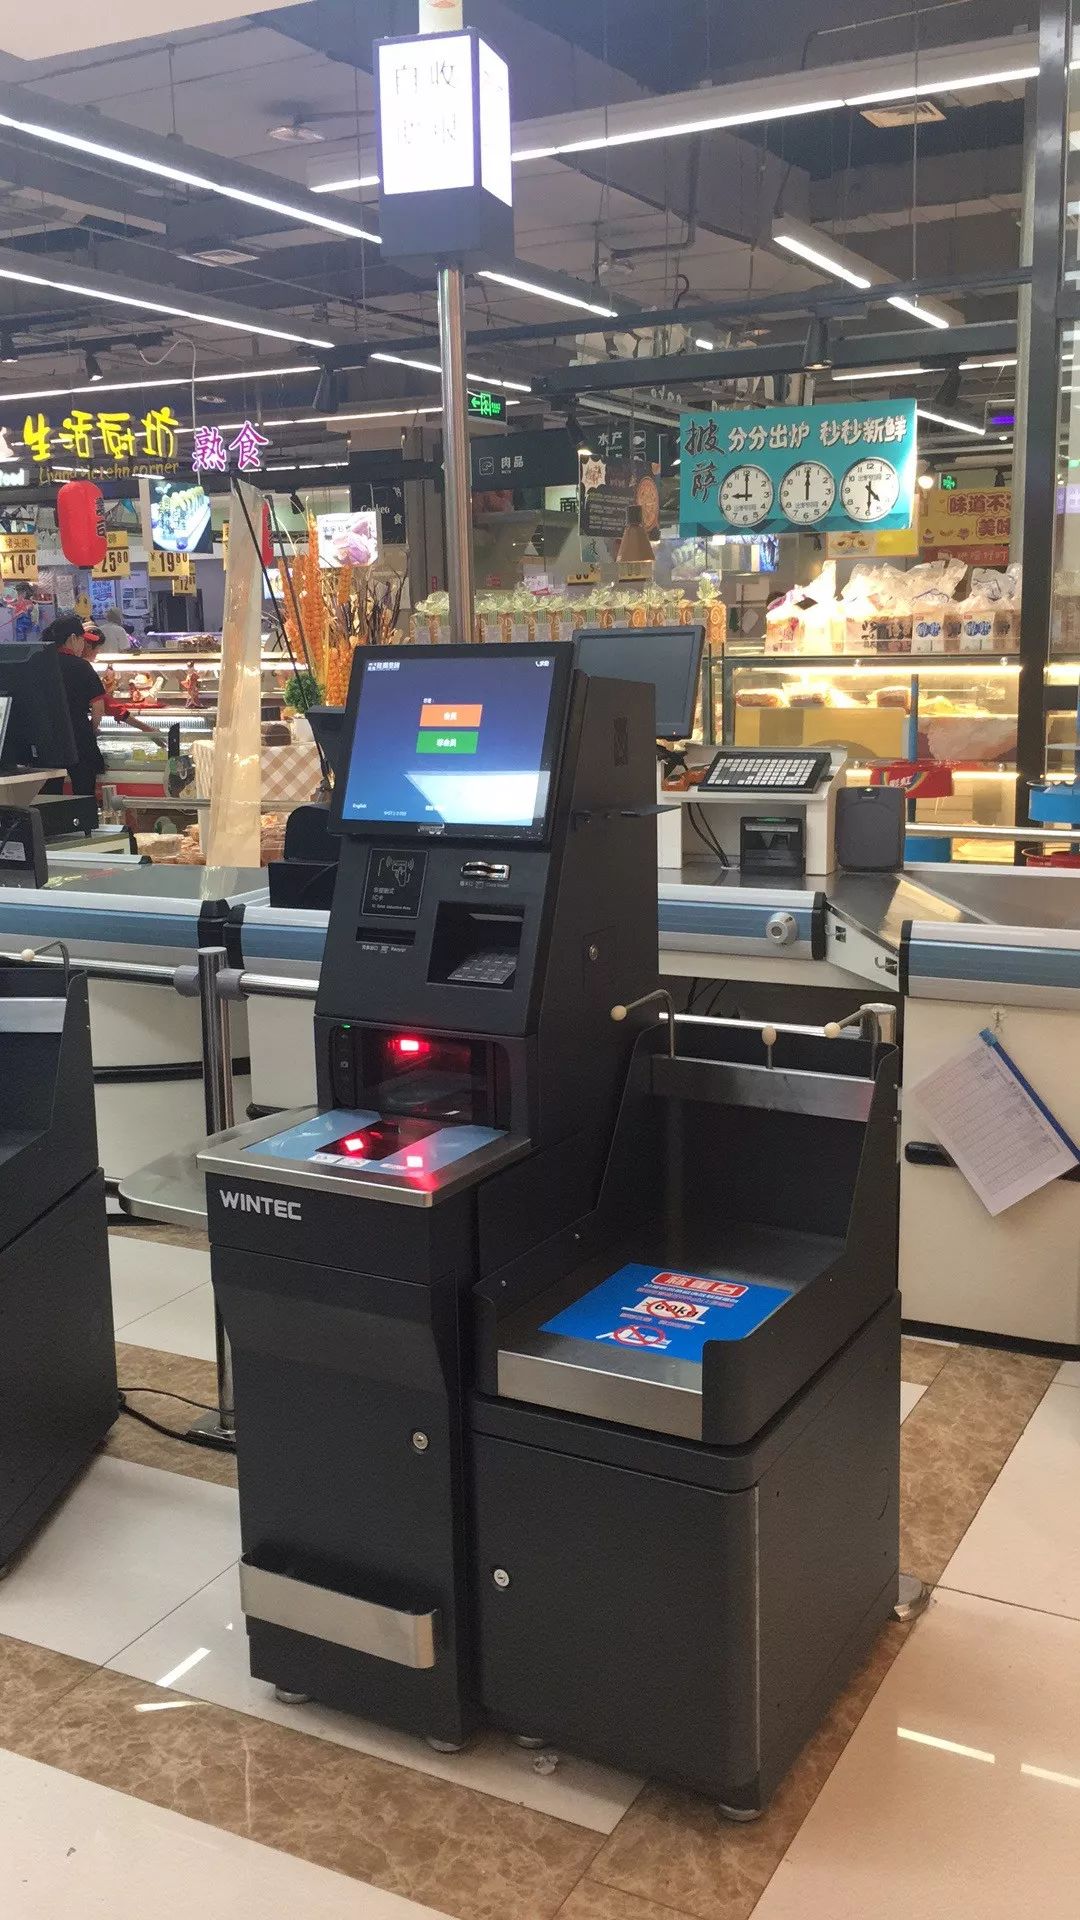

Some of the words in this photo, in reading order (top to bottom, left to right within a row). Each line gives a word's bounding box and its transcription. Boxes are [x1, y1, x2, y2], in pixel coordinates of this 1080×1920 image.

[192, 420, 269, 472] 熟食
[728, 421, 811, 452] 分分出炉
[818, 415, 907, 447] 秒秒新鲜
[501, 455, 524, 469] 肉品
[219, 1189, 302, 1221] WINTEC
